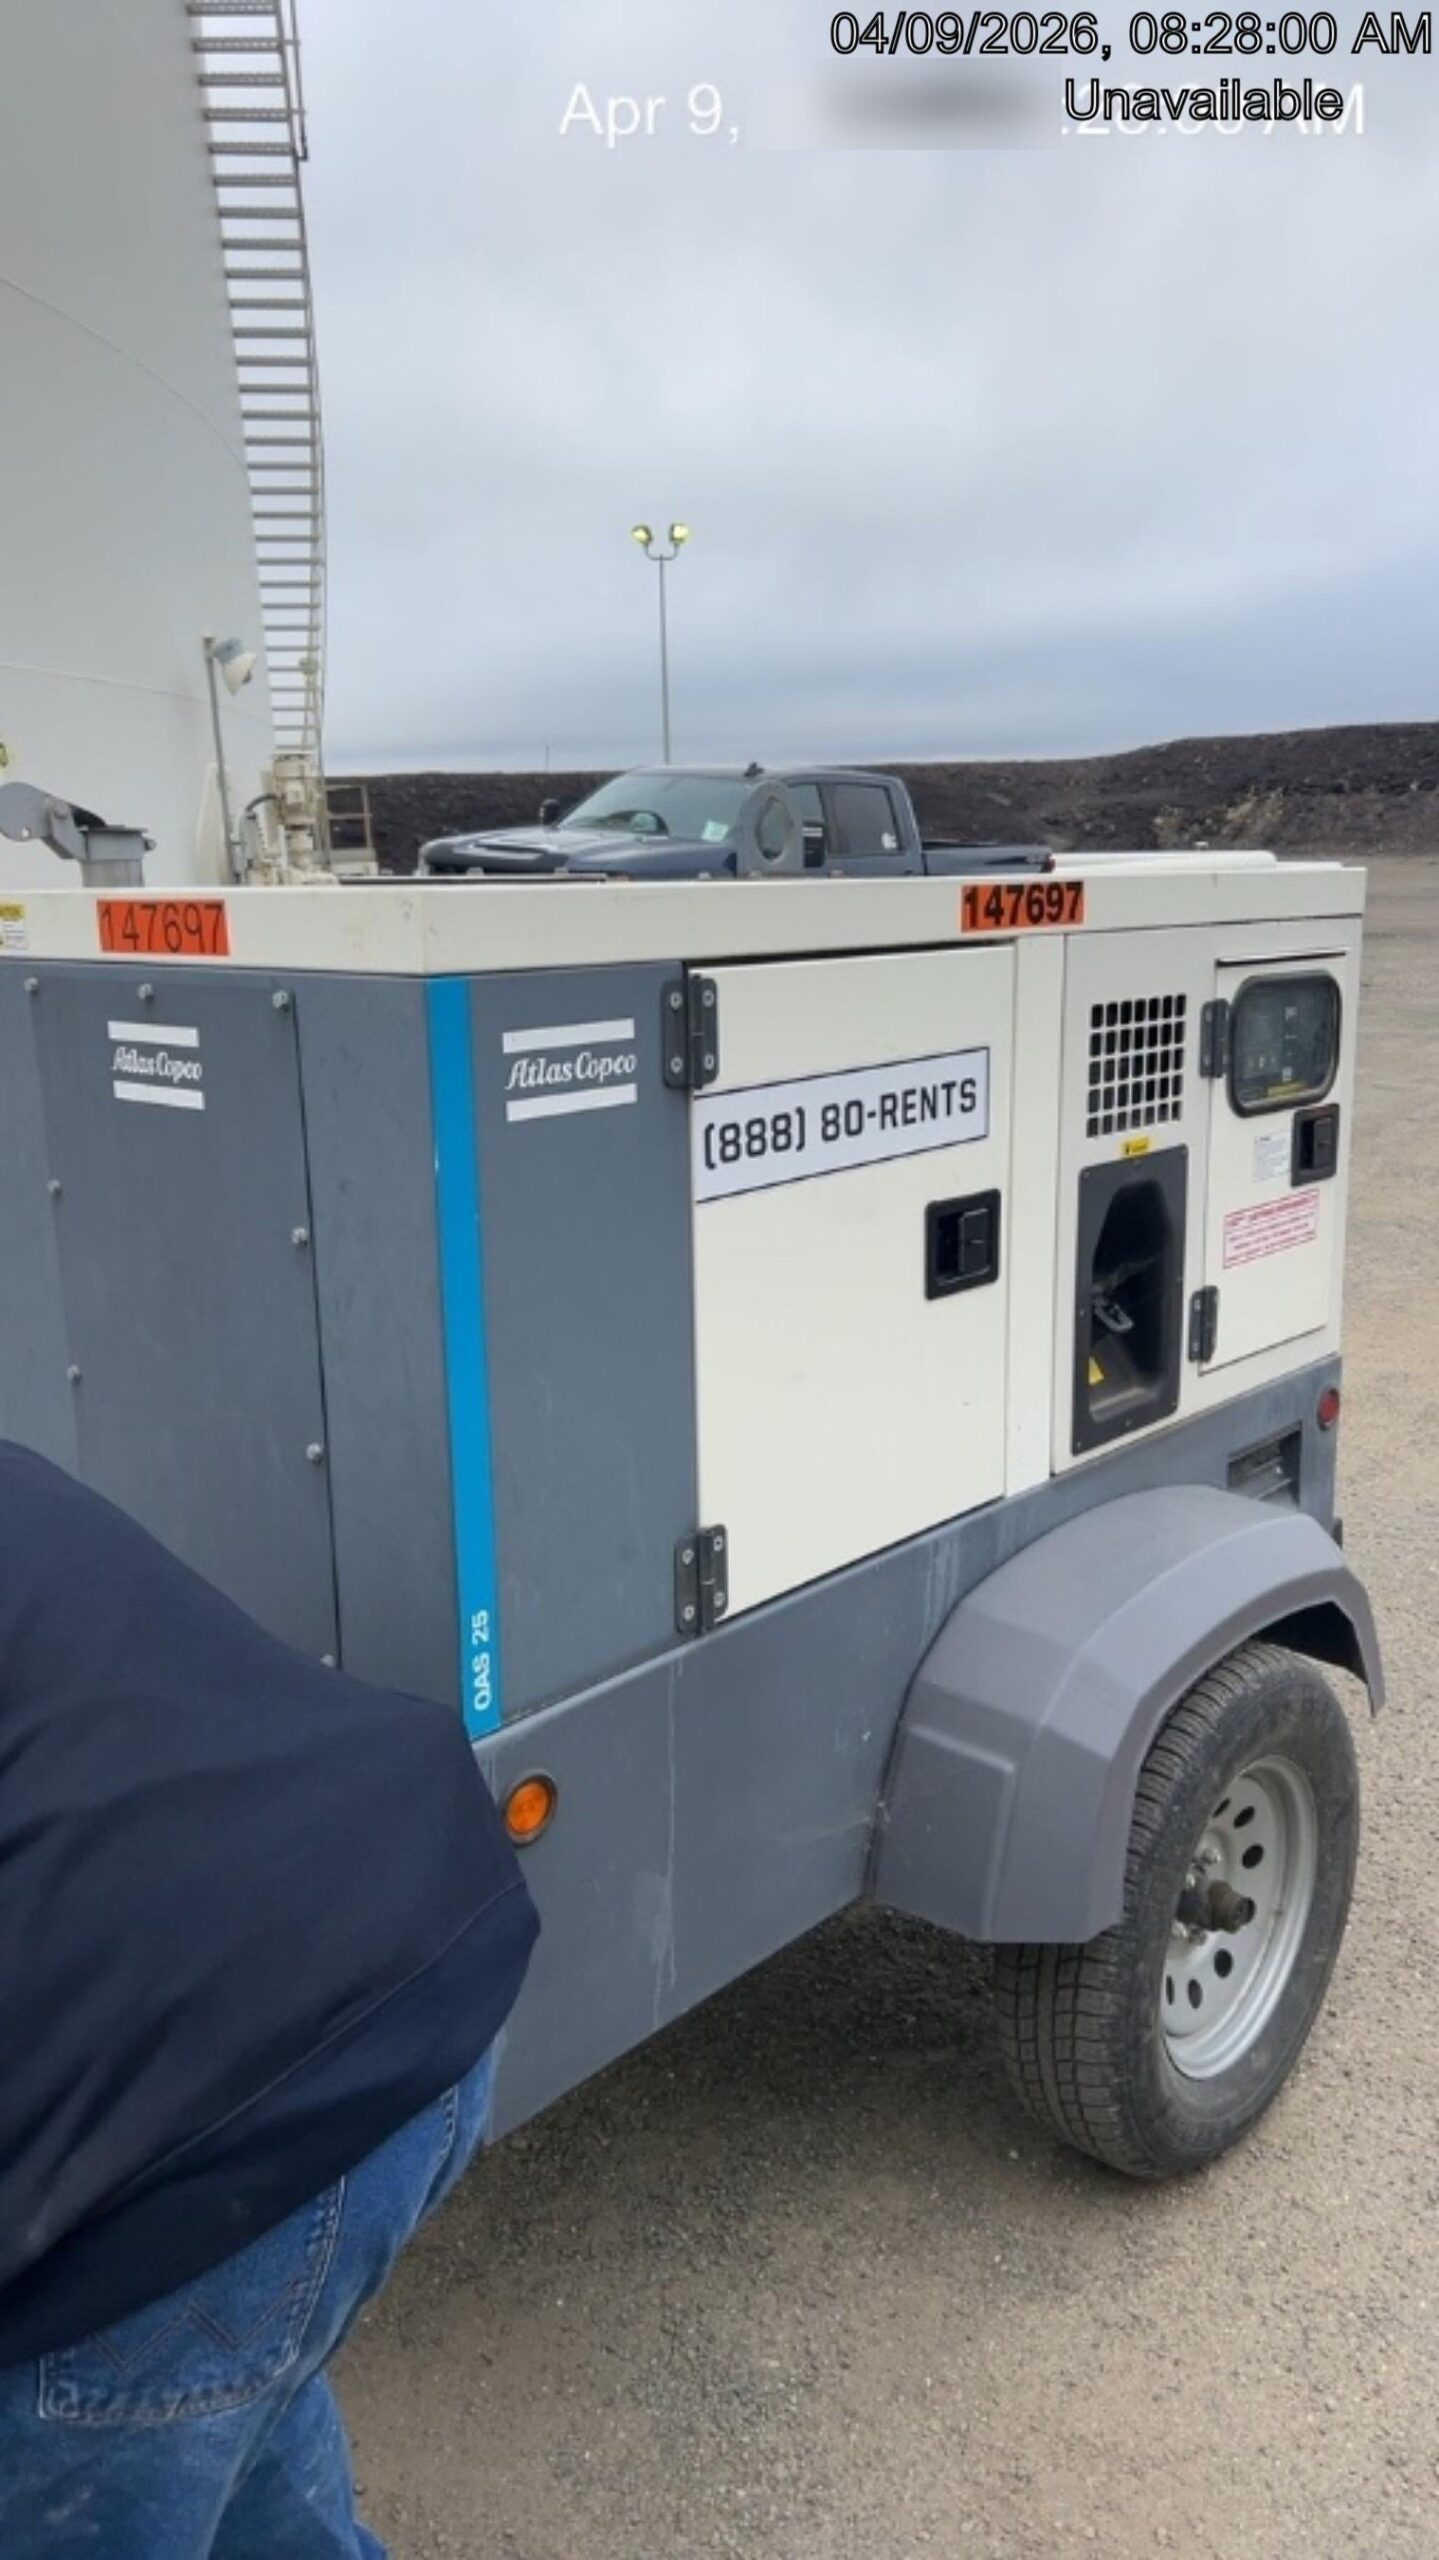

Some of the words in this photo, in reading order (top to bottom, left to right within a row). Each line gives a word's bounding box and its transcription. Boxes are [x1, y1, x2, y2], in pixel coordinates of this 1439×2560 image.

[102, 902, 224, 954] 147697
[963, 881, 1084, 929] 147697
[704, 1106, 806, 1170] (888)
[821, 1078, 977, 1142] 80-RENTS
[471, 1609, 489, 1646] 25
